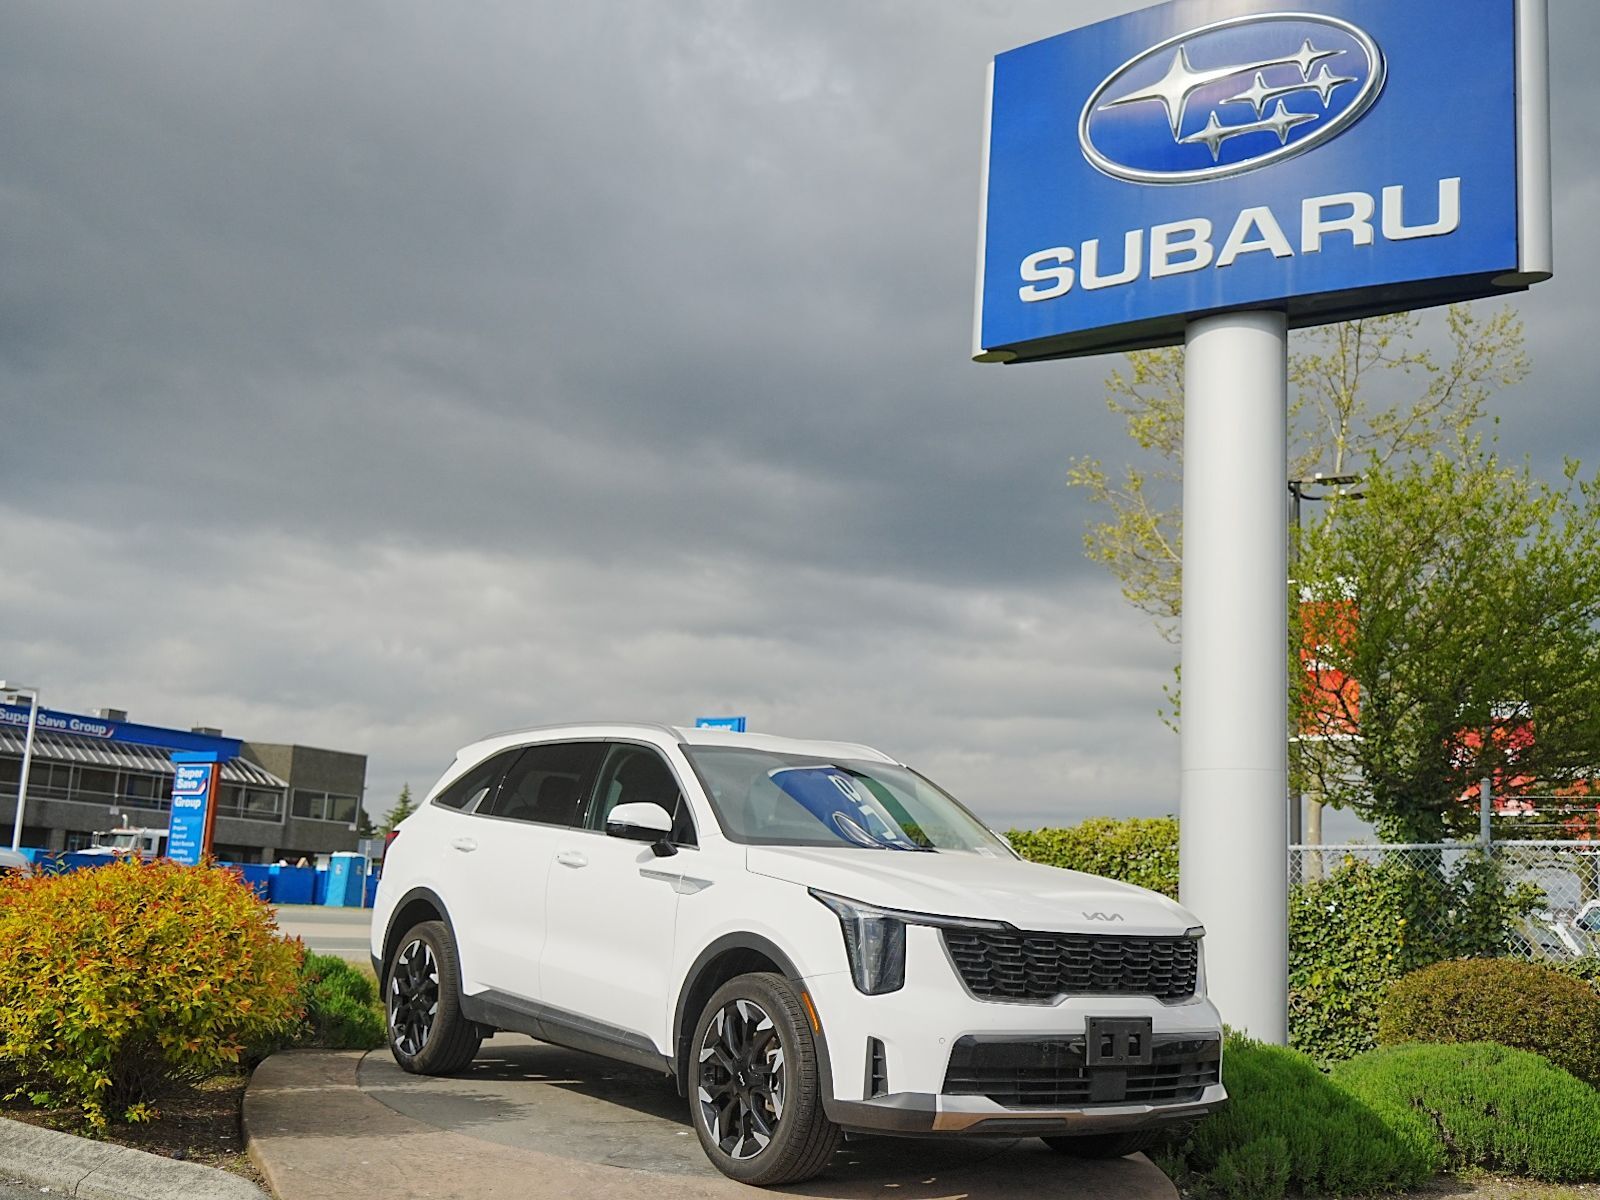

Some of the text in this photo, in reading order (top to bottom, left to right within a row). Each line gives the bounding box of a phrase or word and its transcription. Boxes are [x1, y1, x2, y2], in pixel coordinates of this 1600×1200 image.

[1018, 177, 1461, 302] SUBARU
[0, 708, 107, 736] Supe Save Group
[177, 767, 204, 780] Super
[176, 779, 198, 789] Save
[174, 796, 202, 810] Group
